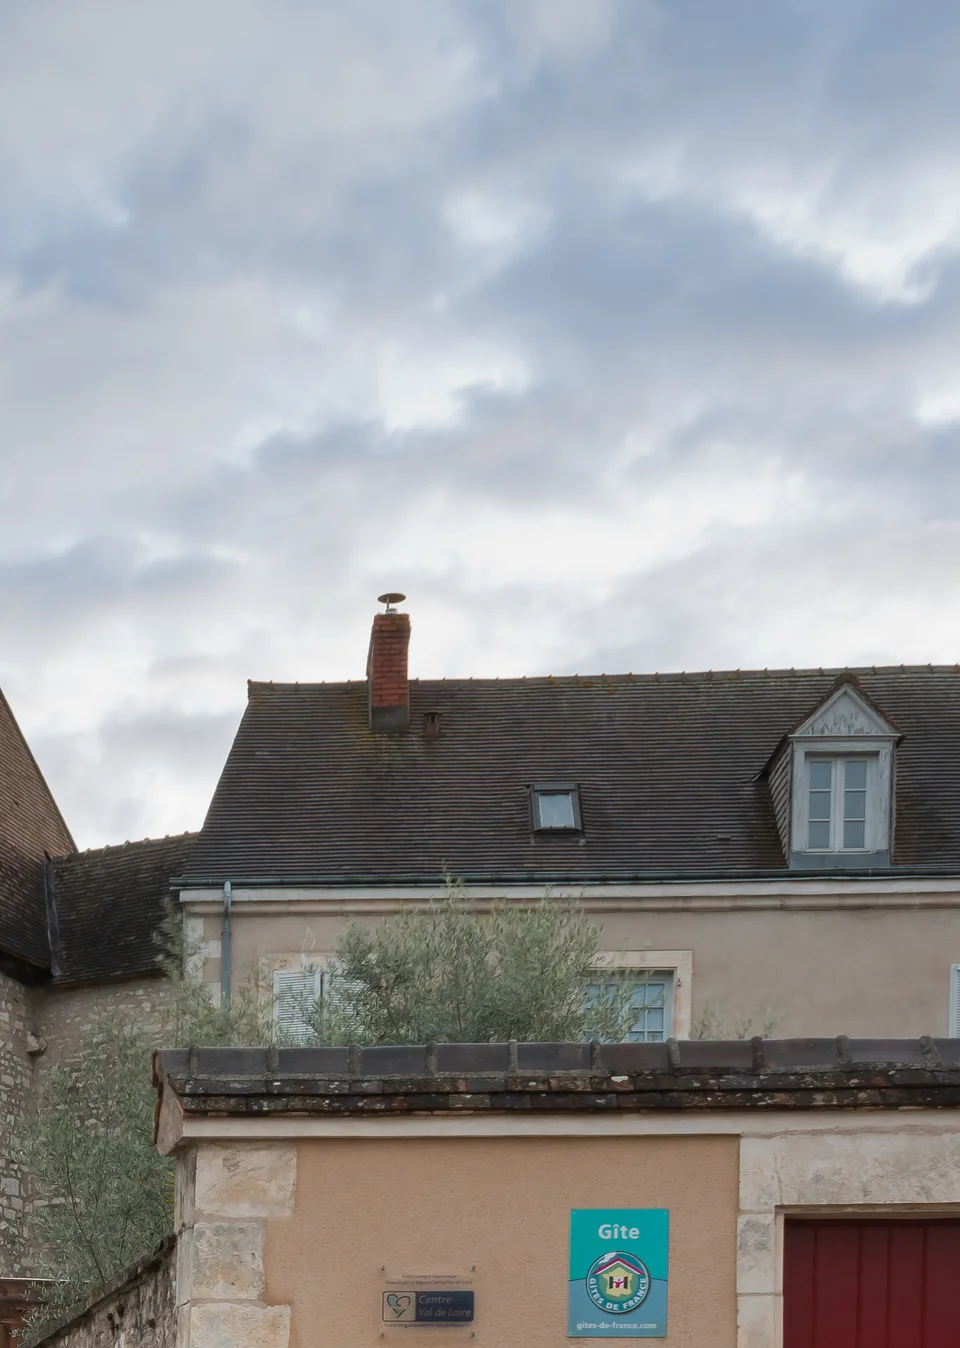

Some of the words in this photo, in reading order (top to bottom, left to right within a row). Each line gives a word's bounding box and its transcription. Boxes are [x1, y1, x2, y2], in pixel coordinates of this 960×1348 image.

[598, 1223, 640, 1239] Gîte
[418, 1294, 452, 1304] Centre
[606, 1302, 619, 1311] DE
[622, 1277, 647, 1310] FRANCE
[419, 1308, 433, 1317] Val
[434, 1308, 446, 1317] de
[448, 1308, 472, 1317] Loire
[576, 1322, 657, 1331] gites-de-france.com
